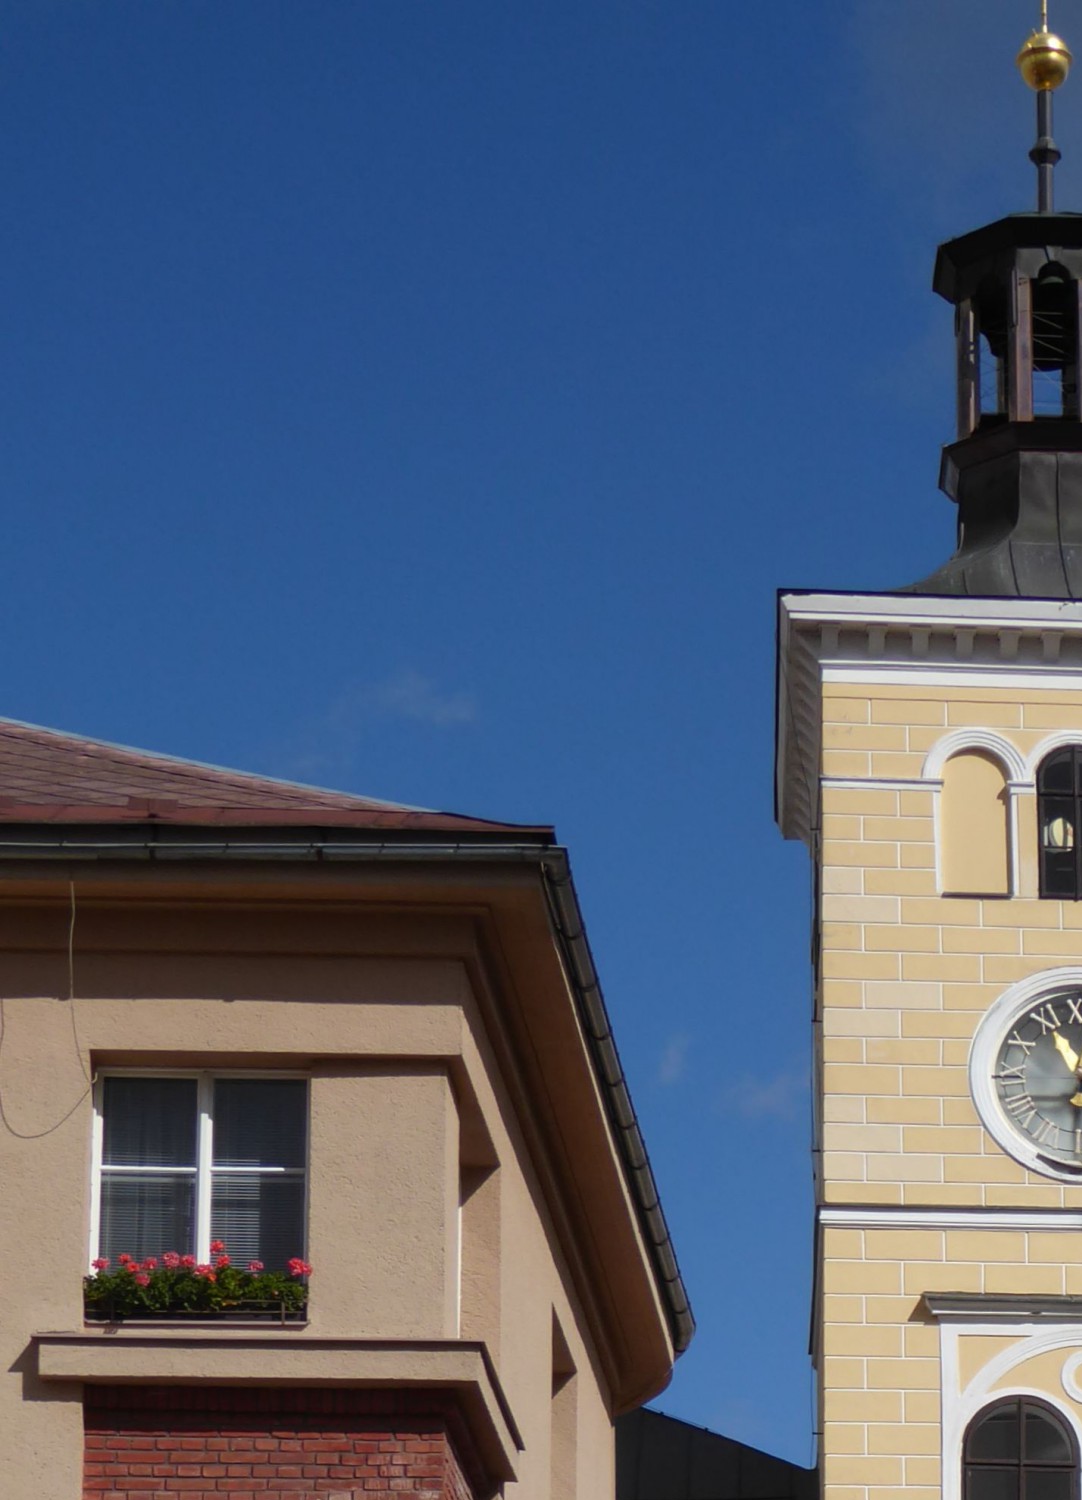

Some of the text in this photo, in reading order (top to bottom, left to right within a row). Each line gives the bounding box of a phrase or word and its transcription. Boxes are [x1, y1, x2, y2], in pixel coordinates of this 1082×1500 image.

[1030, 1004, 1061, 1035] XI
[1007, 1031, 1036, 1055] X
[1000, 1061, 1027, 1085] IX
[1005, 1092, 1037, 1129] VIII
